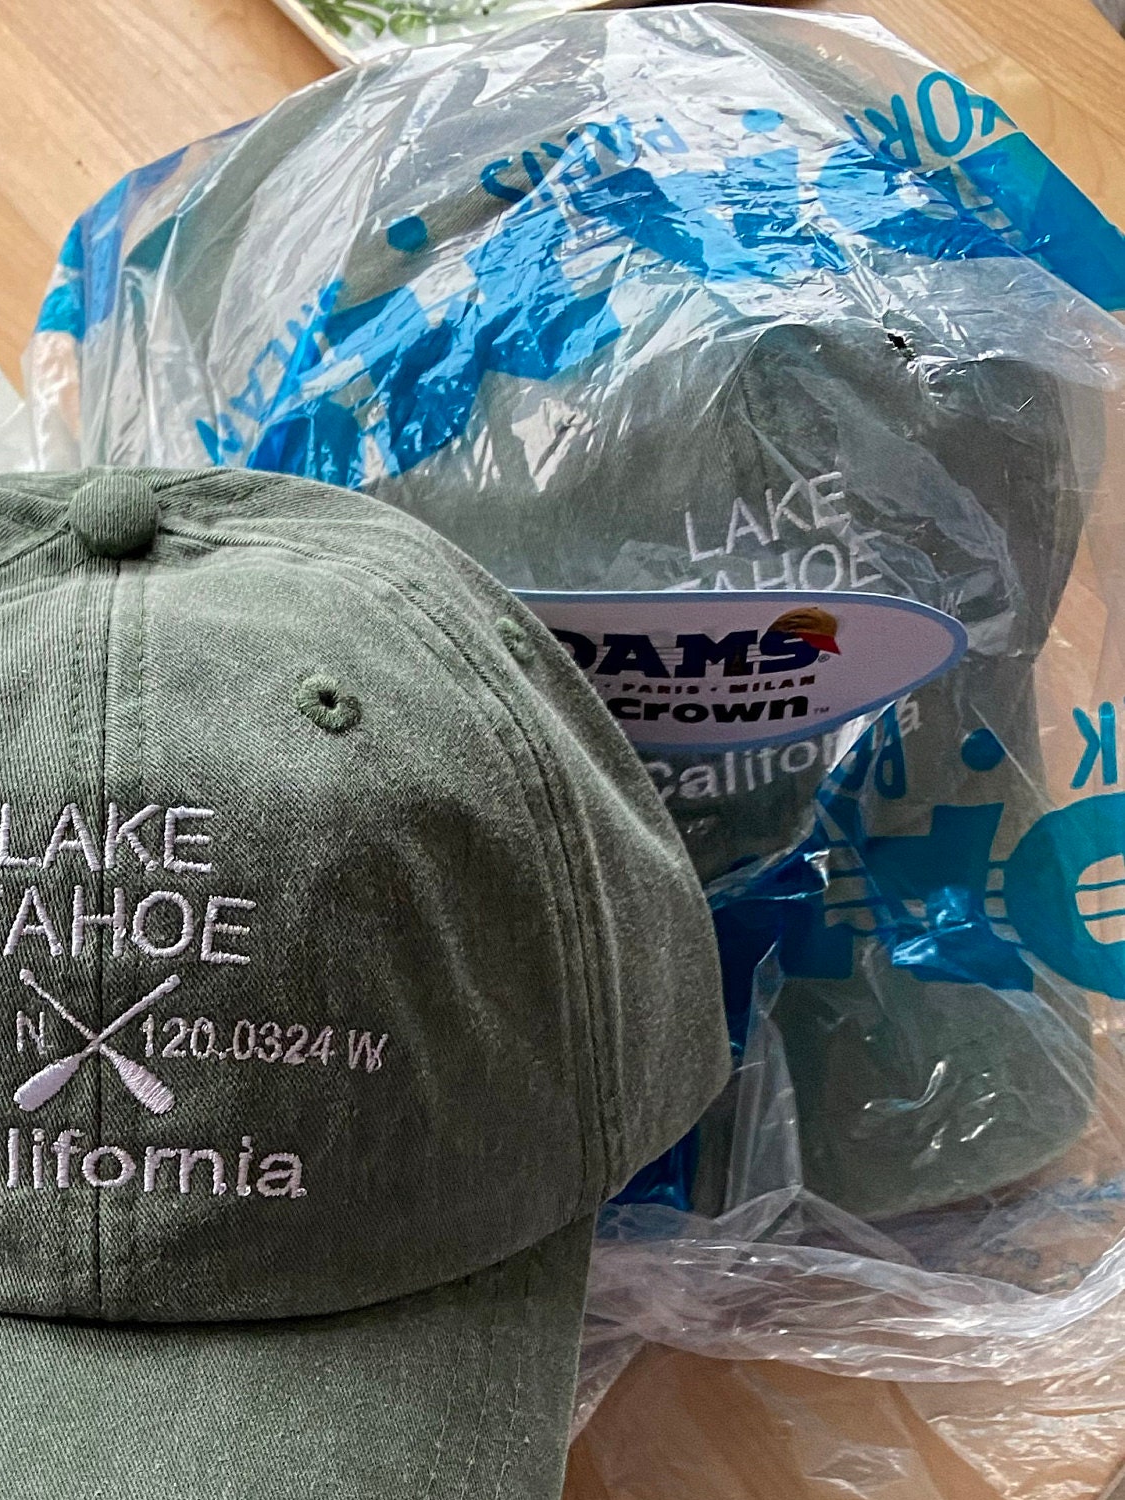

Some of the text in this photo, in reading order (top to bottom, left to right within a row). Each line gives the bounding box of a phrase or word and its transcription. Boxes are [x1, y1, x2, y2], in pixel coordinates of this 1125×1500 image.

[685, 470, 851, 562] LAKE
[662, 530, 883, 591] HOE
[622, 675, 816, 694] PARIS MILAN
[16, 1010, 47, 1056] N
[140, 1013, 336, 1066] 120.0324
[348, 1031, 388, 1074] W
